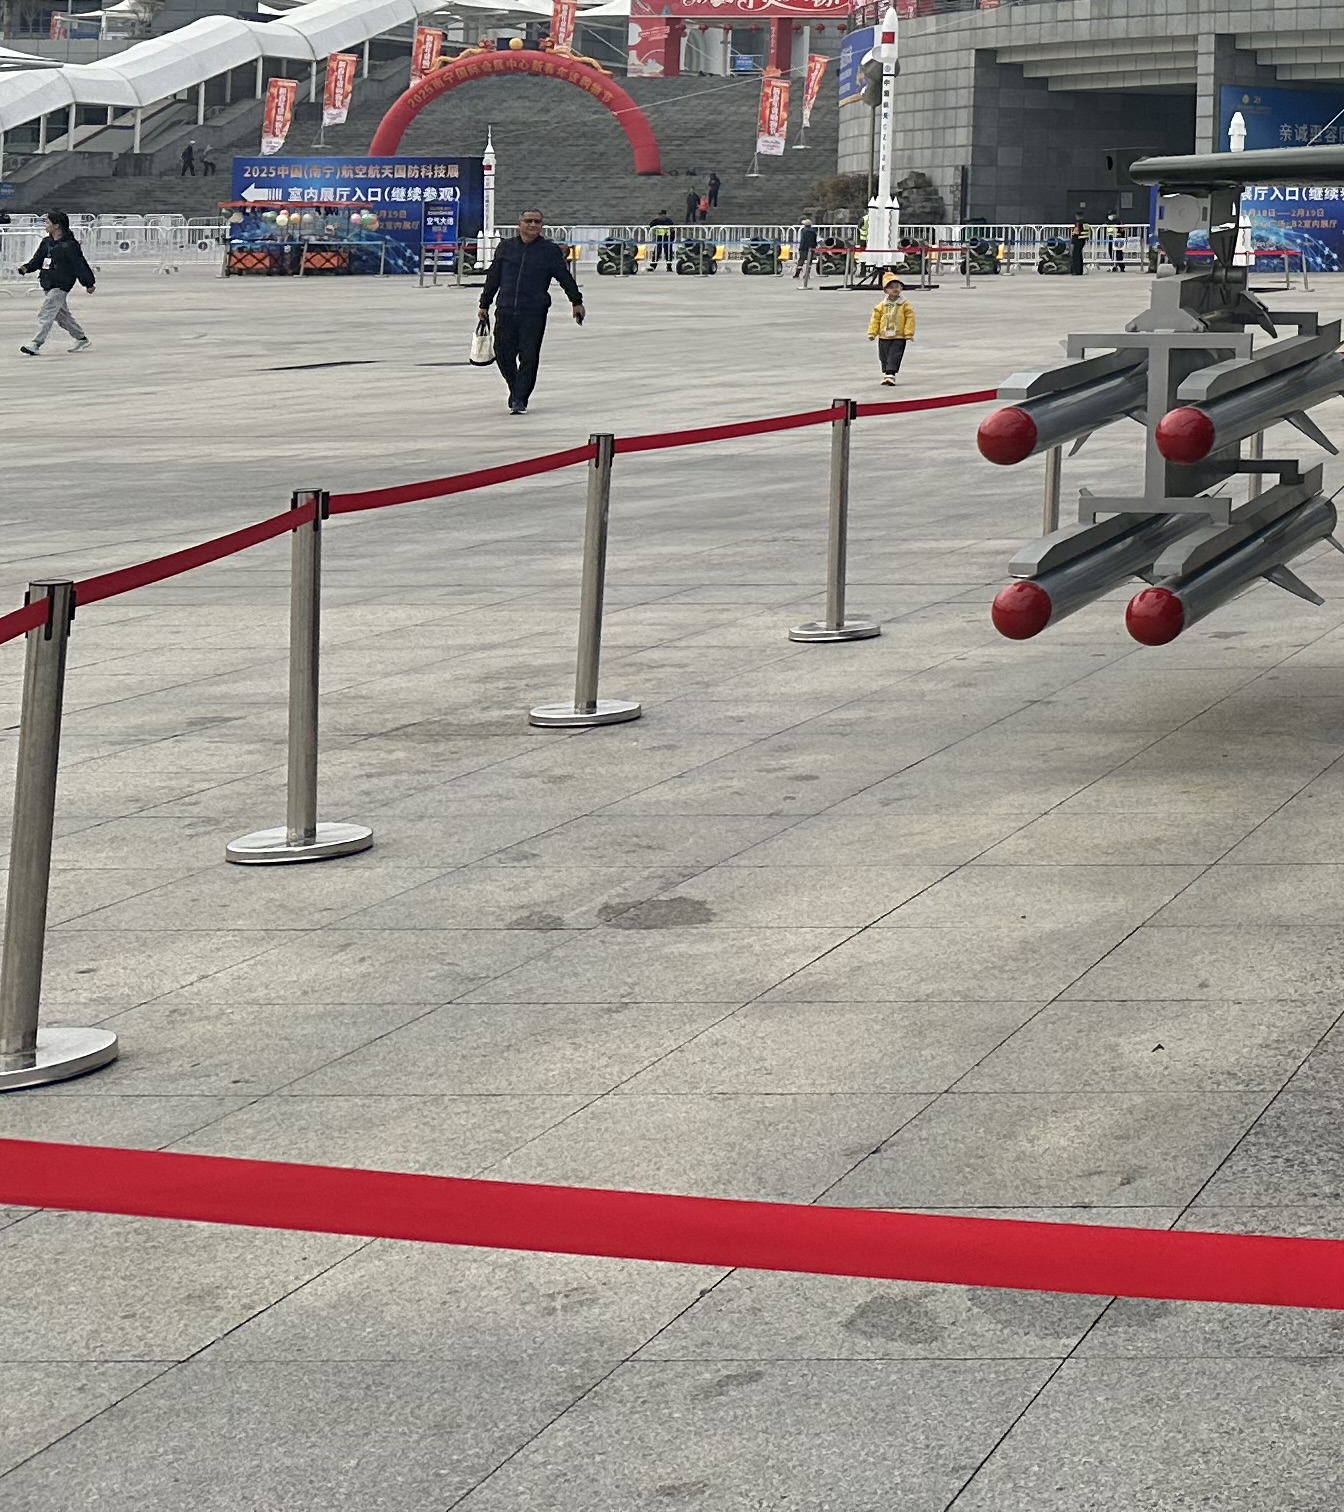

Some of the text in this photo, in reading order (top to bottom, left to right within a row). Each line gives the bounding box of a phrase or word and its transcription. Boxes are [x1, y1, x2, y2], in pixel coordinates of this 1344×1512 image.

[288, 186, 460, 202] 室内展厅入口(继续参观)
